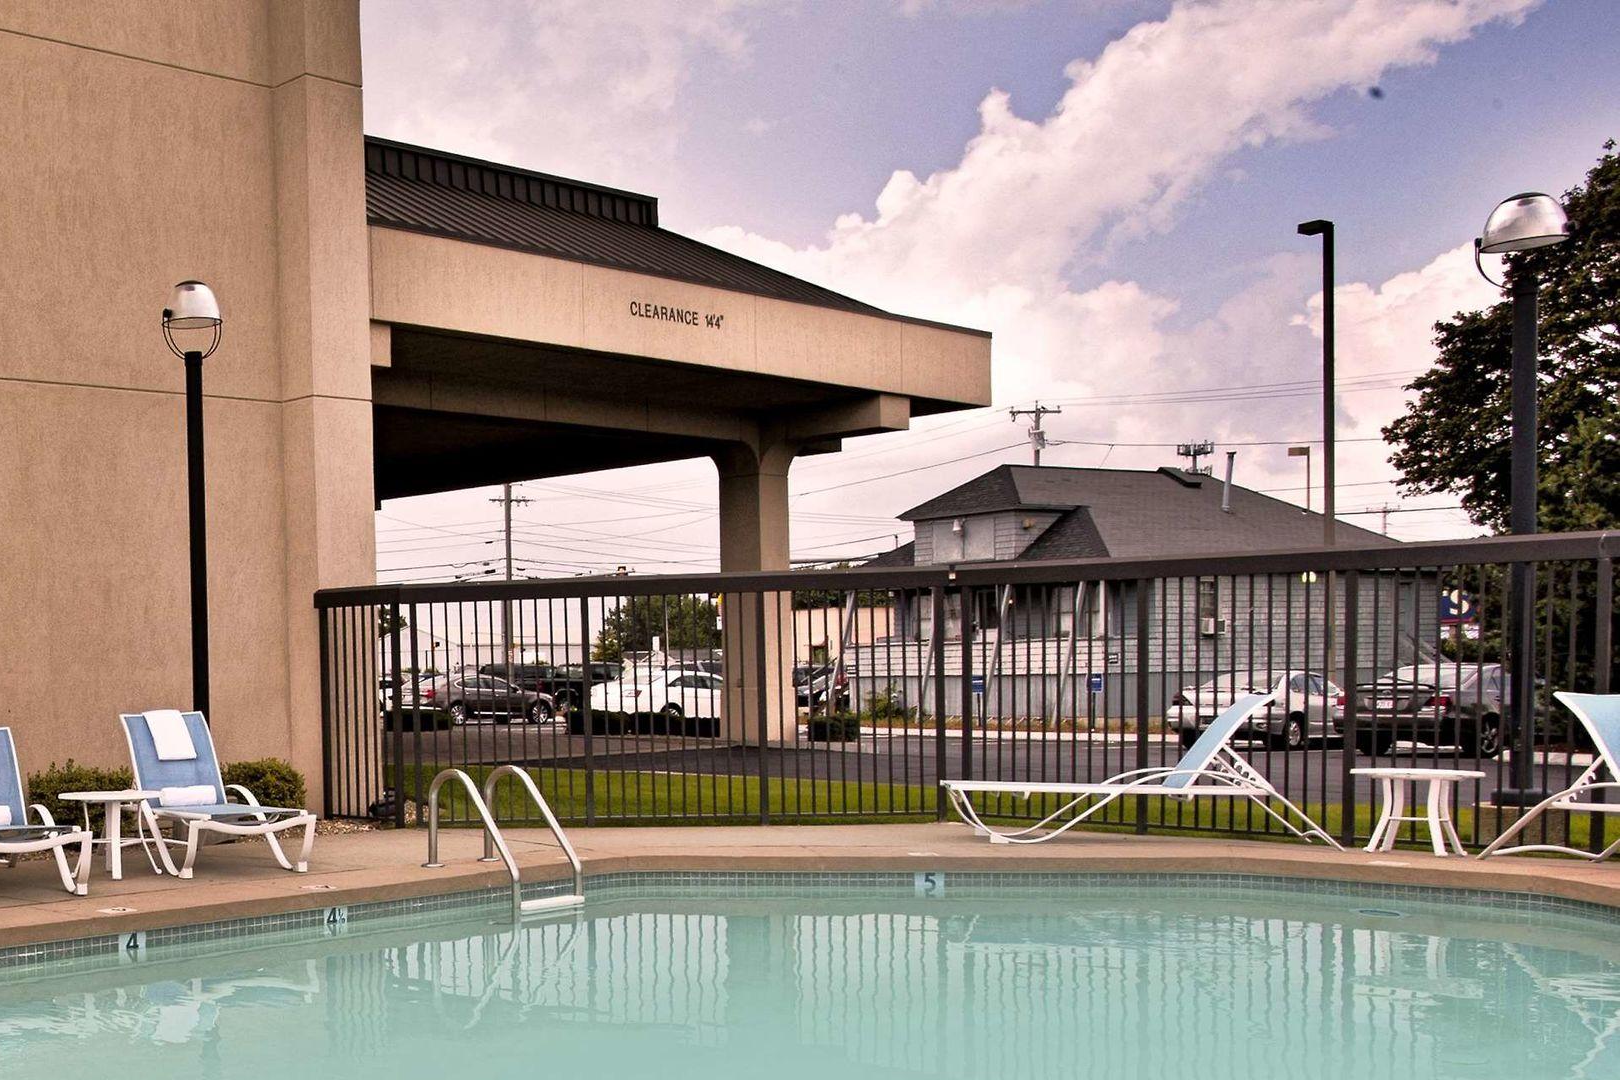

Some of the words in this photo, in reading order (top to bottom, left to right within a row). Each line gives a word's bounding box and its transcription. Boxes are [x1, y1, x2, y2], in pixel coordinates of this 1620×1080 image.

[630, 301, 699, 326] CLEARANCE
[924, 872, 936, 890] 5
[126, 931, 139, 949] 4
